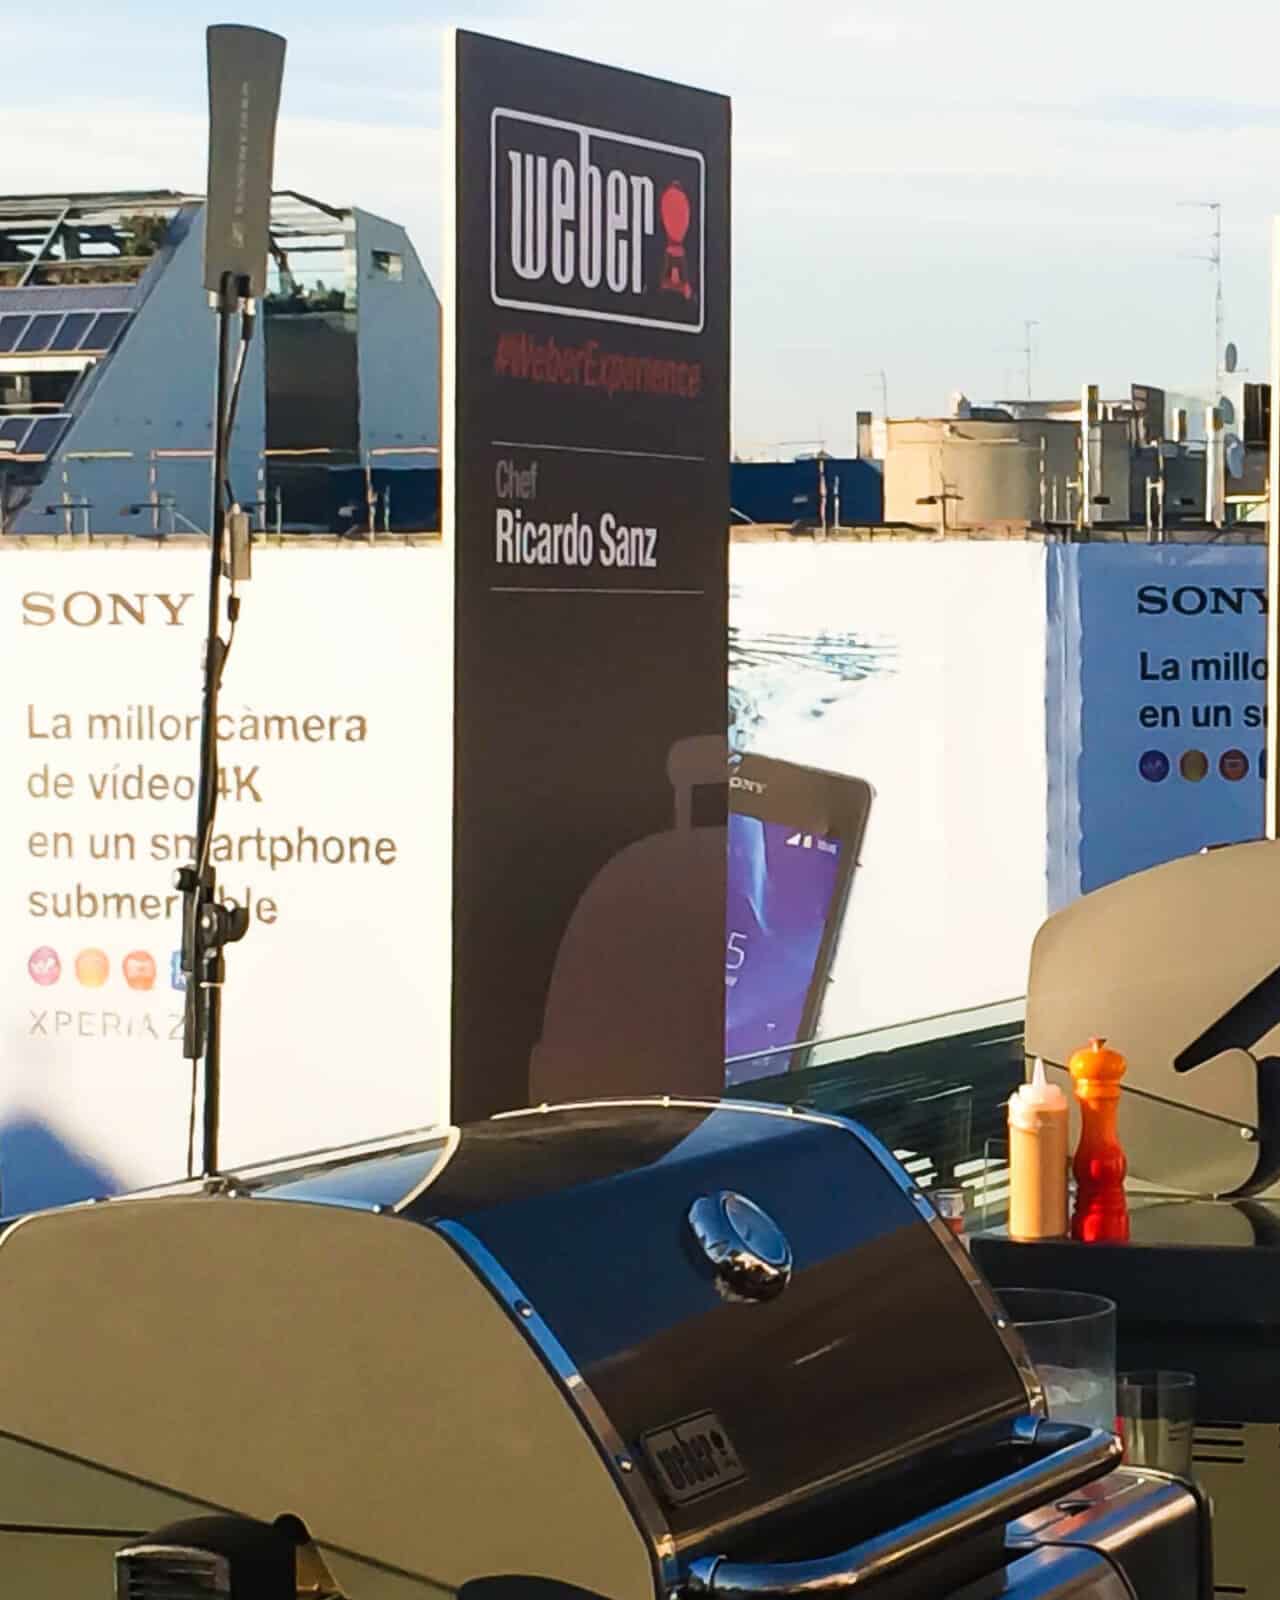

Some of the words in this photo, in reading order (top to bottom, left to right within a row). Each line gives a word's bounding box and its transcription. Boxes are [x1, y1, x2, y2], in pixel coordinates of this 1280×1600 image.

[508, 127, 654, 293] weber
[495, 459, 537, 498] Chef
[496, 508, 593, 566] Ricardo
[600, 513, 657, 567] Sanz
[22, 591, 195, 626] SONY
[1139, 651, 1180, 681] La
[1191, 651, 1268, 681] millo
[27, 704, 71, 739] La
[88, 705, 200, 741] millor
[215, 705, 367, 742] càmera
[1139, 704, 1180, 728] en
[1192, 705, 1231, 728] un
[28, 764, 74, 799] de
[88, 763, 195, 801] vídeo
[729, 776, 767, 794] ONY
[28, 831, 73, 858] en
[90, 833, 135, 860] un
[29, 882, 278, 924] submerble
[28, 1010, 159, 1039] XPERIA
